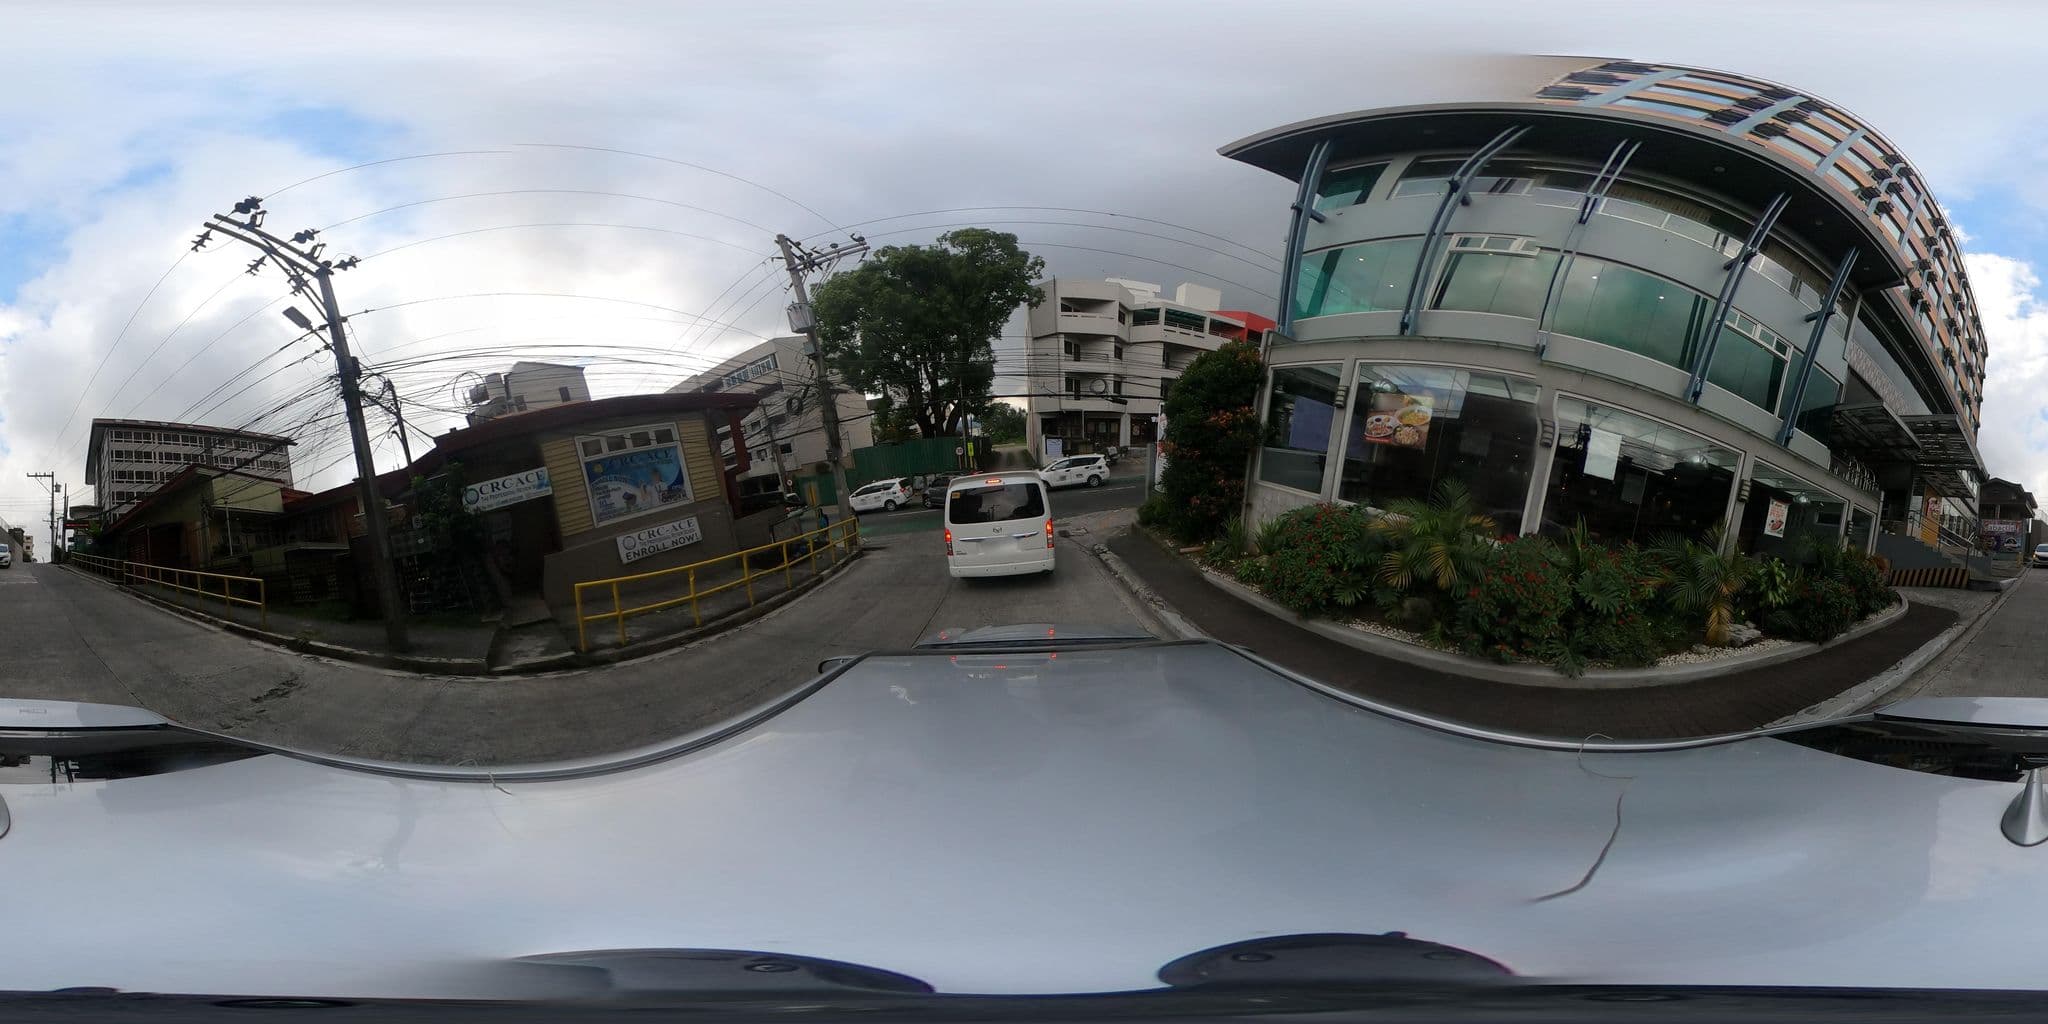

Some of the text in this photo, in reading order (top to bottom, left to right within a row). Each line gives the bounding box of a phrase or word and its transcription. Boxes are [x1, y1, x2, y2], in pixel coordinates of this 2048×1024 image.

[638, 519, 695, 541] CRC-ACE
[626, 542, 668, 561] ENROLL
[671, 532, 699, 547] NOW!
